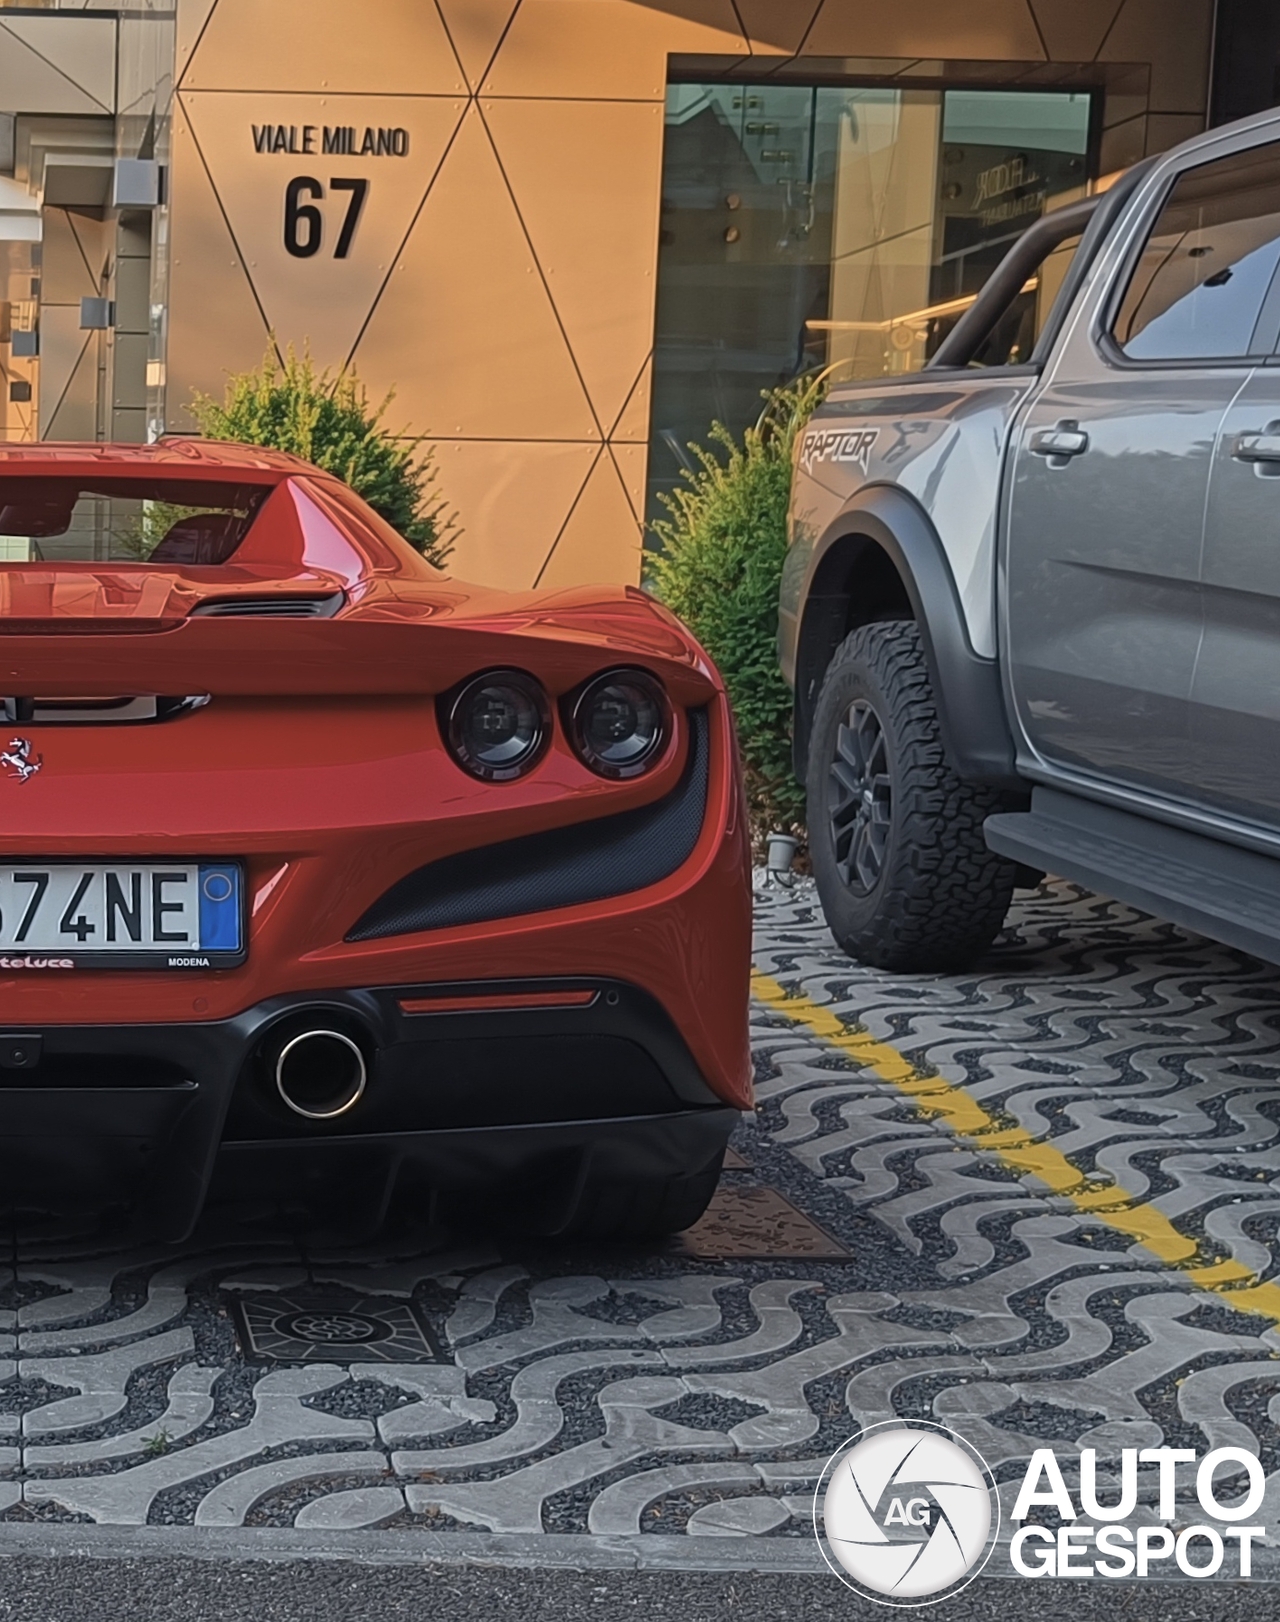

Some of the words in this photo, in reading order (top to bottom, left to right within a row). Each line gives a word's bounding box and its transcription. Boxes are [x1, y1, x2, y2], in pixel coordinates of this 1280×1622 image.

[251, 124, 318, 154] VIALE
[322, 126, 409, 157] MILANO
[284, 175, 370, 259] 67
[800, 427, 880, 476] RAPTOR
[168, 957, 210, 967] MODENA
